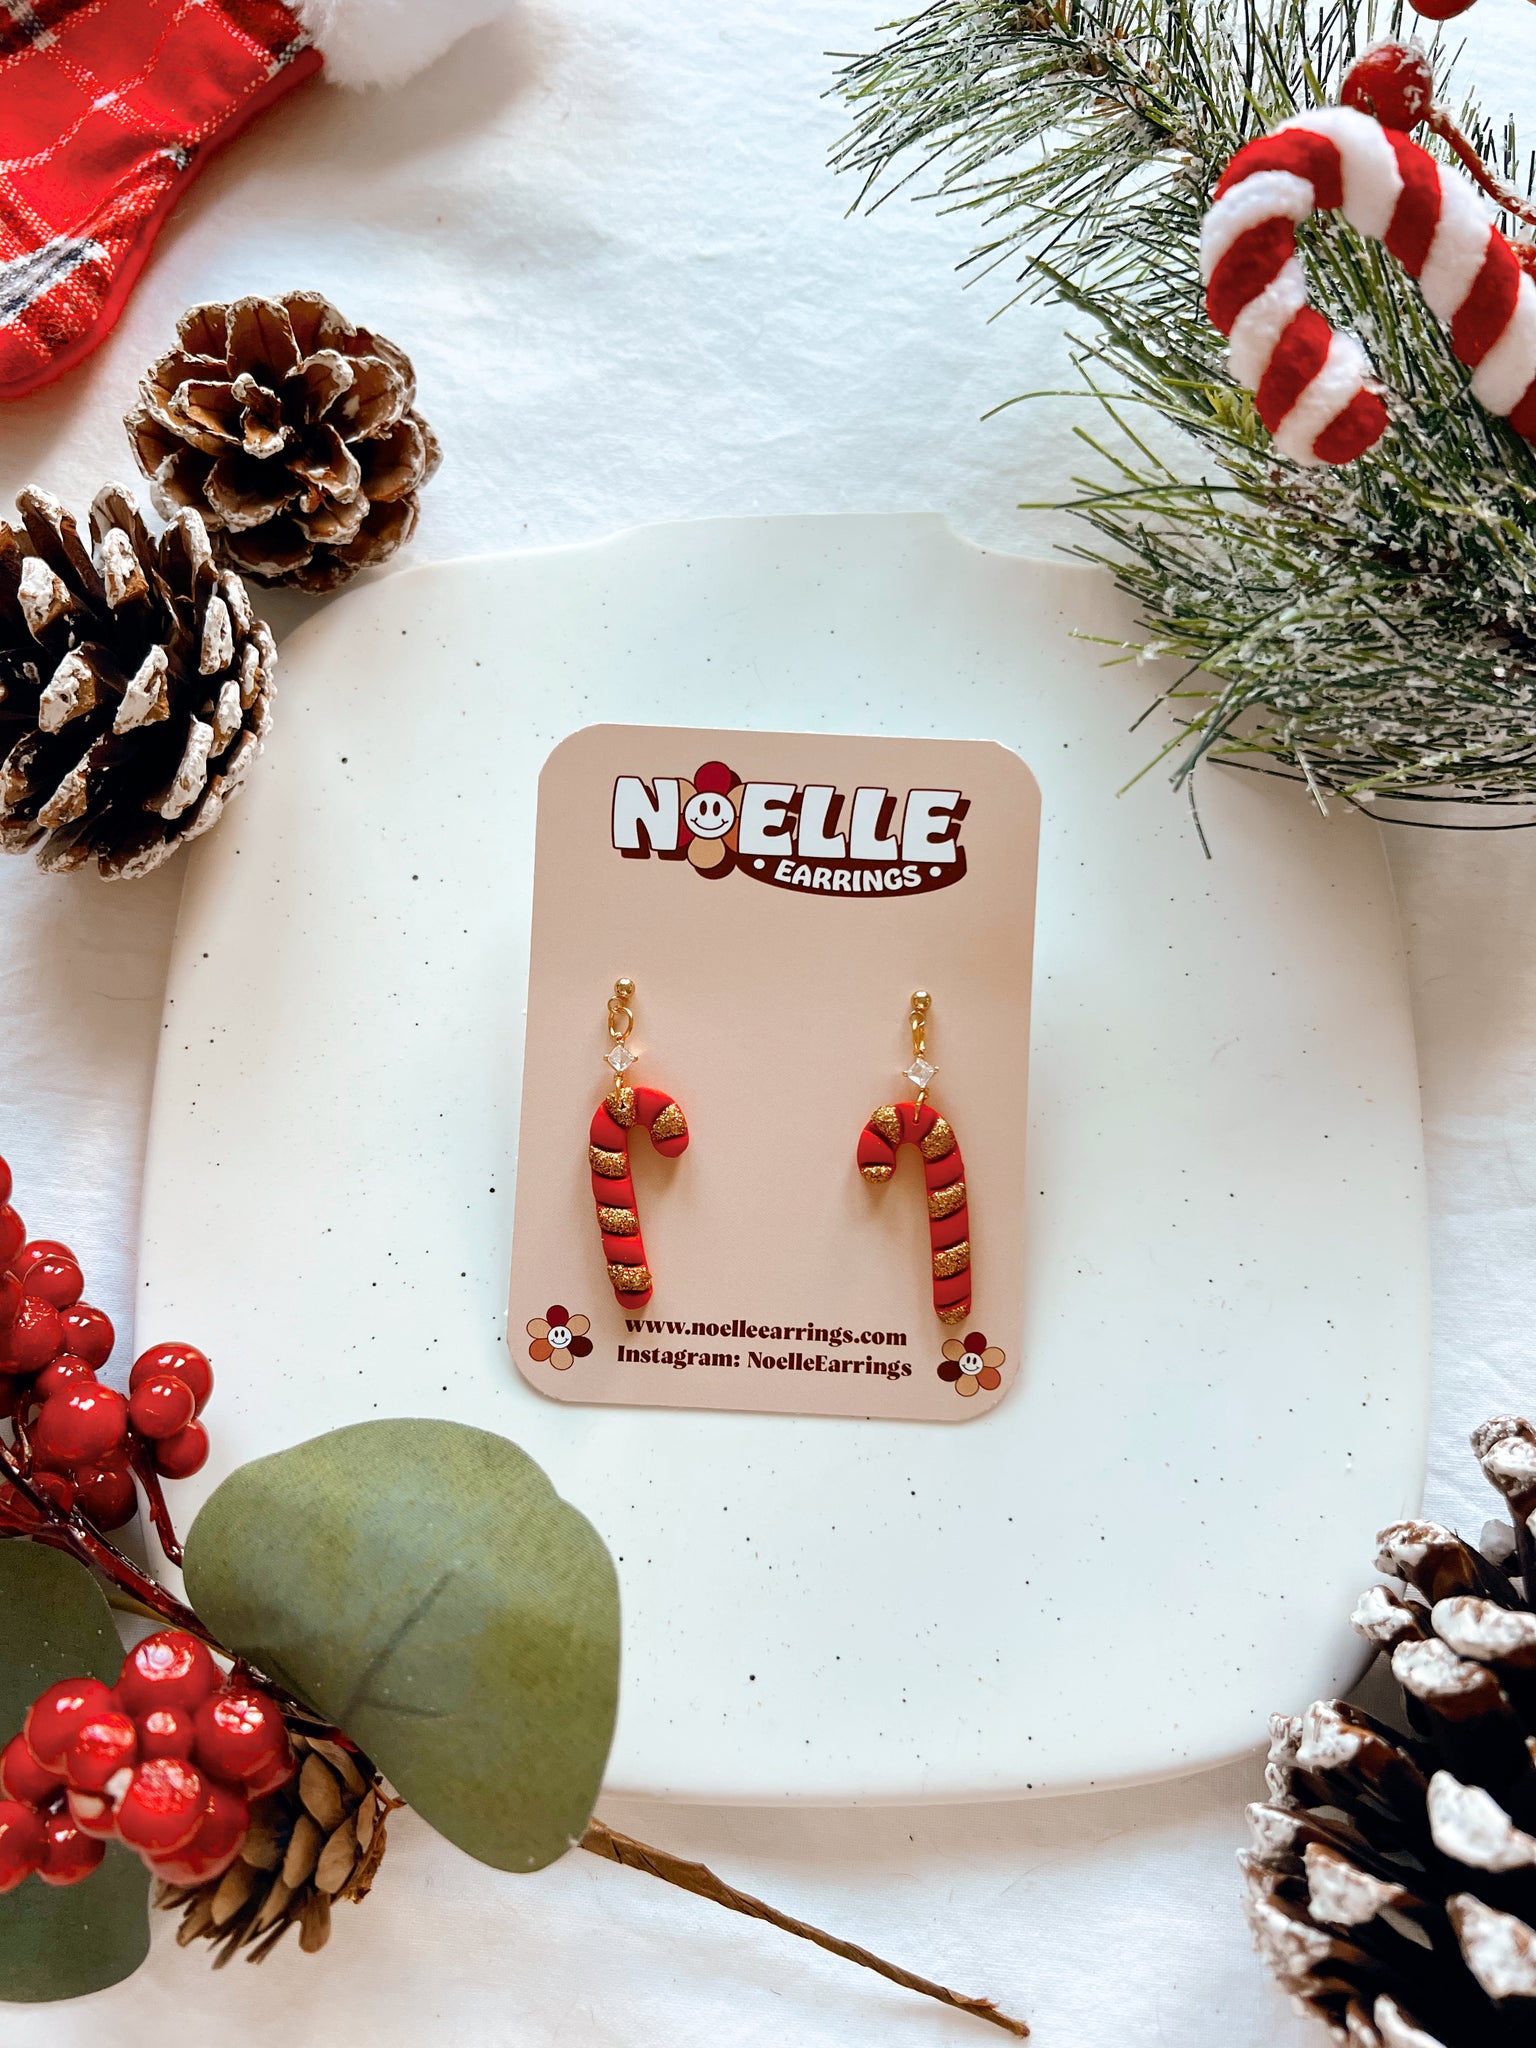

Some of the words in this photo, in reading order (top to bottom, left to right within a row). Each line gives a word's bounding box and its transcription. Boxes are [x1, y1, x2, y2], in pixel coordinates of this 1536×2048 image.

[612, 774, 970, 864] NOELLE
[773, 859, 922, 892] EARRINGS
[625, 1318, 907, 1347] www.noelleearrings.com
[617, 1345, 740, 1369] Instagram:
[748, 1351, 912, 1380] NoelleEarrings
